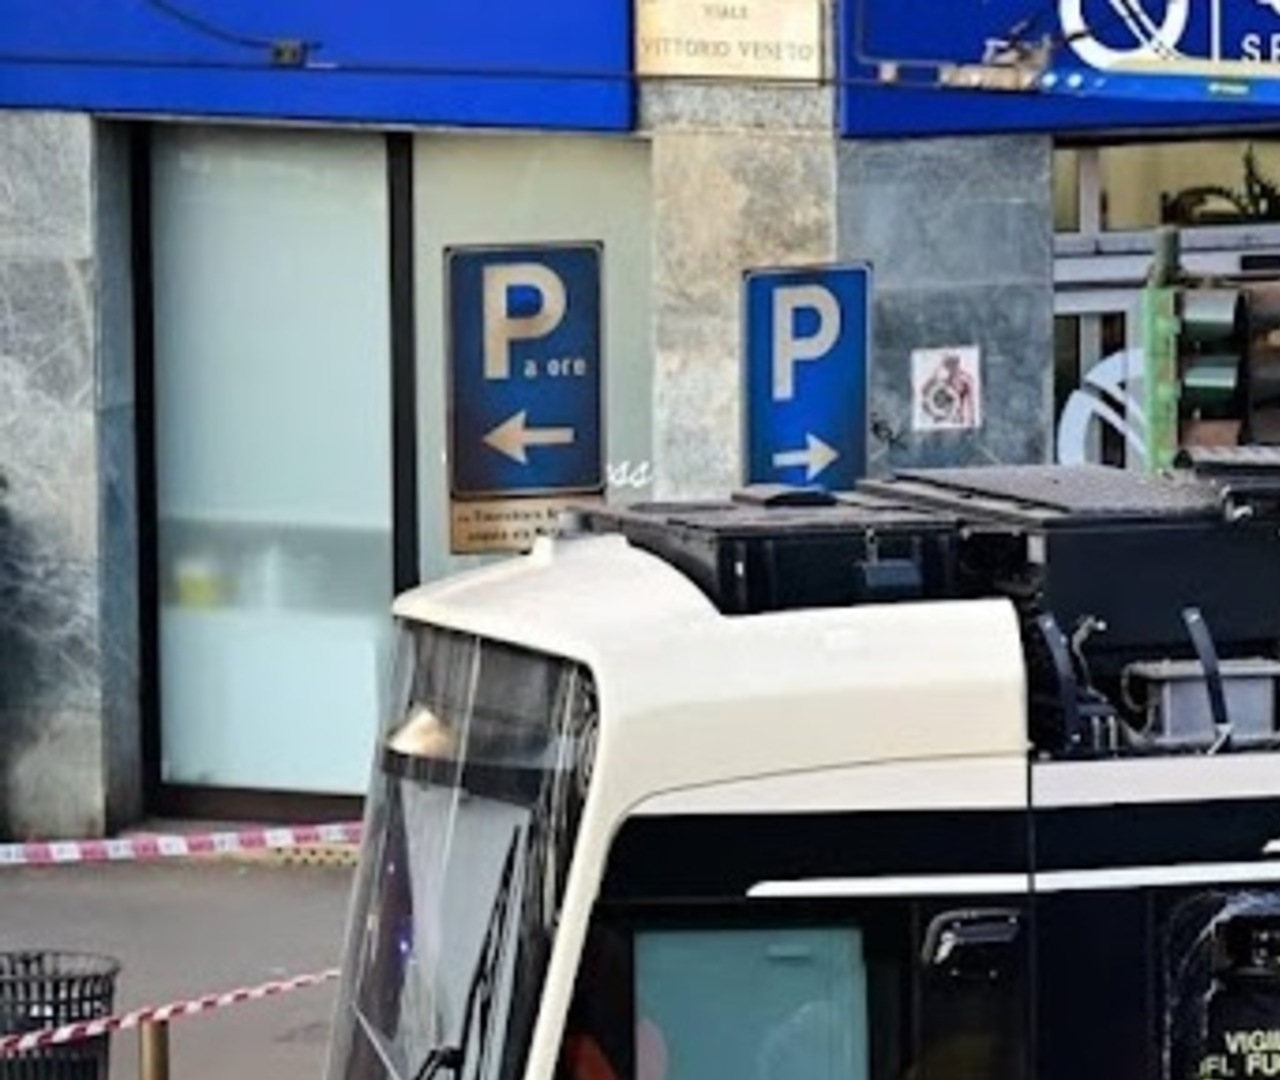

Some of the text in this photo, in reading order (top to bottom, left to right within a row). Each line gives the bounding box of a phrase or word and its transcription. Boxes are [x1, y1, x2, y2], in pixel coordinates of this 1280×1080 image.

[640, 37, 814, 61] VITTORIO VENETO
[483, 262, 567, 379] P
[771, 284, 842, 401] P
[523, 358, 587, 378] a ore
